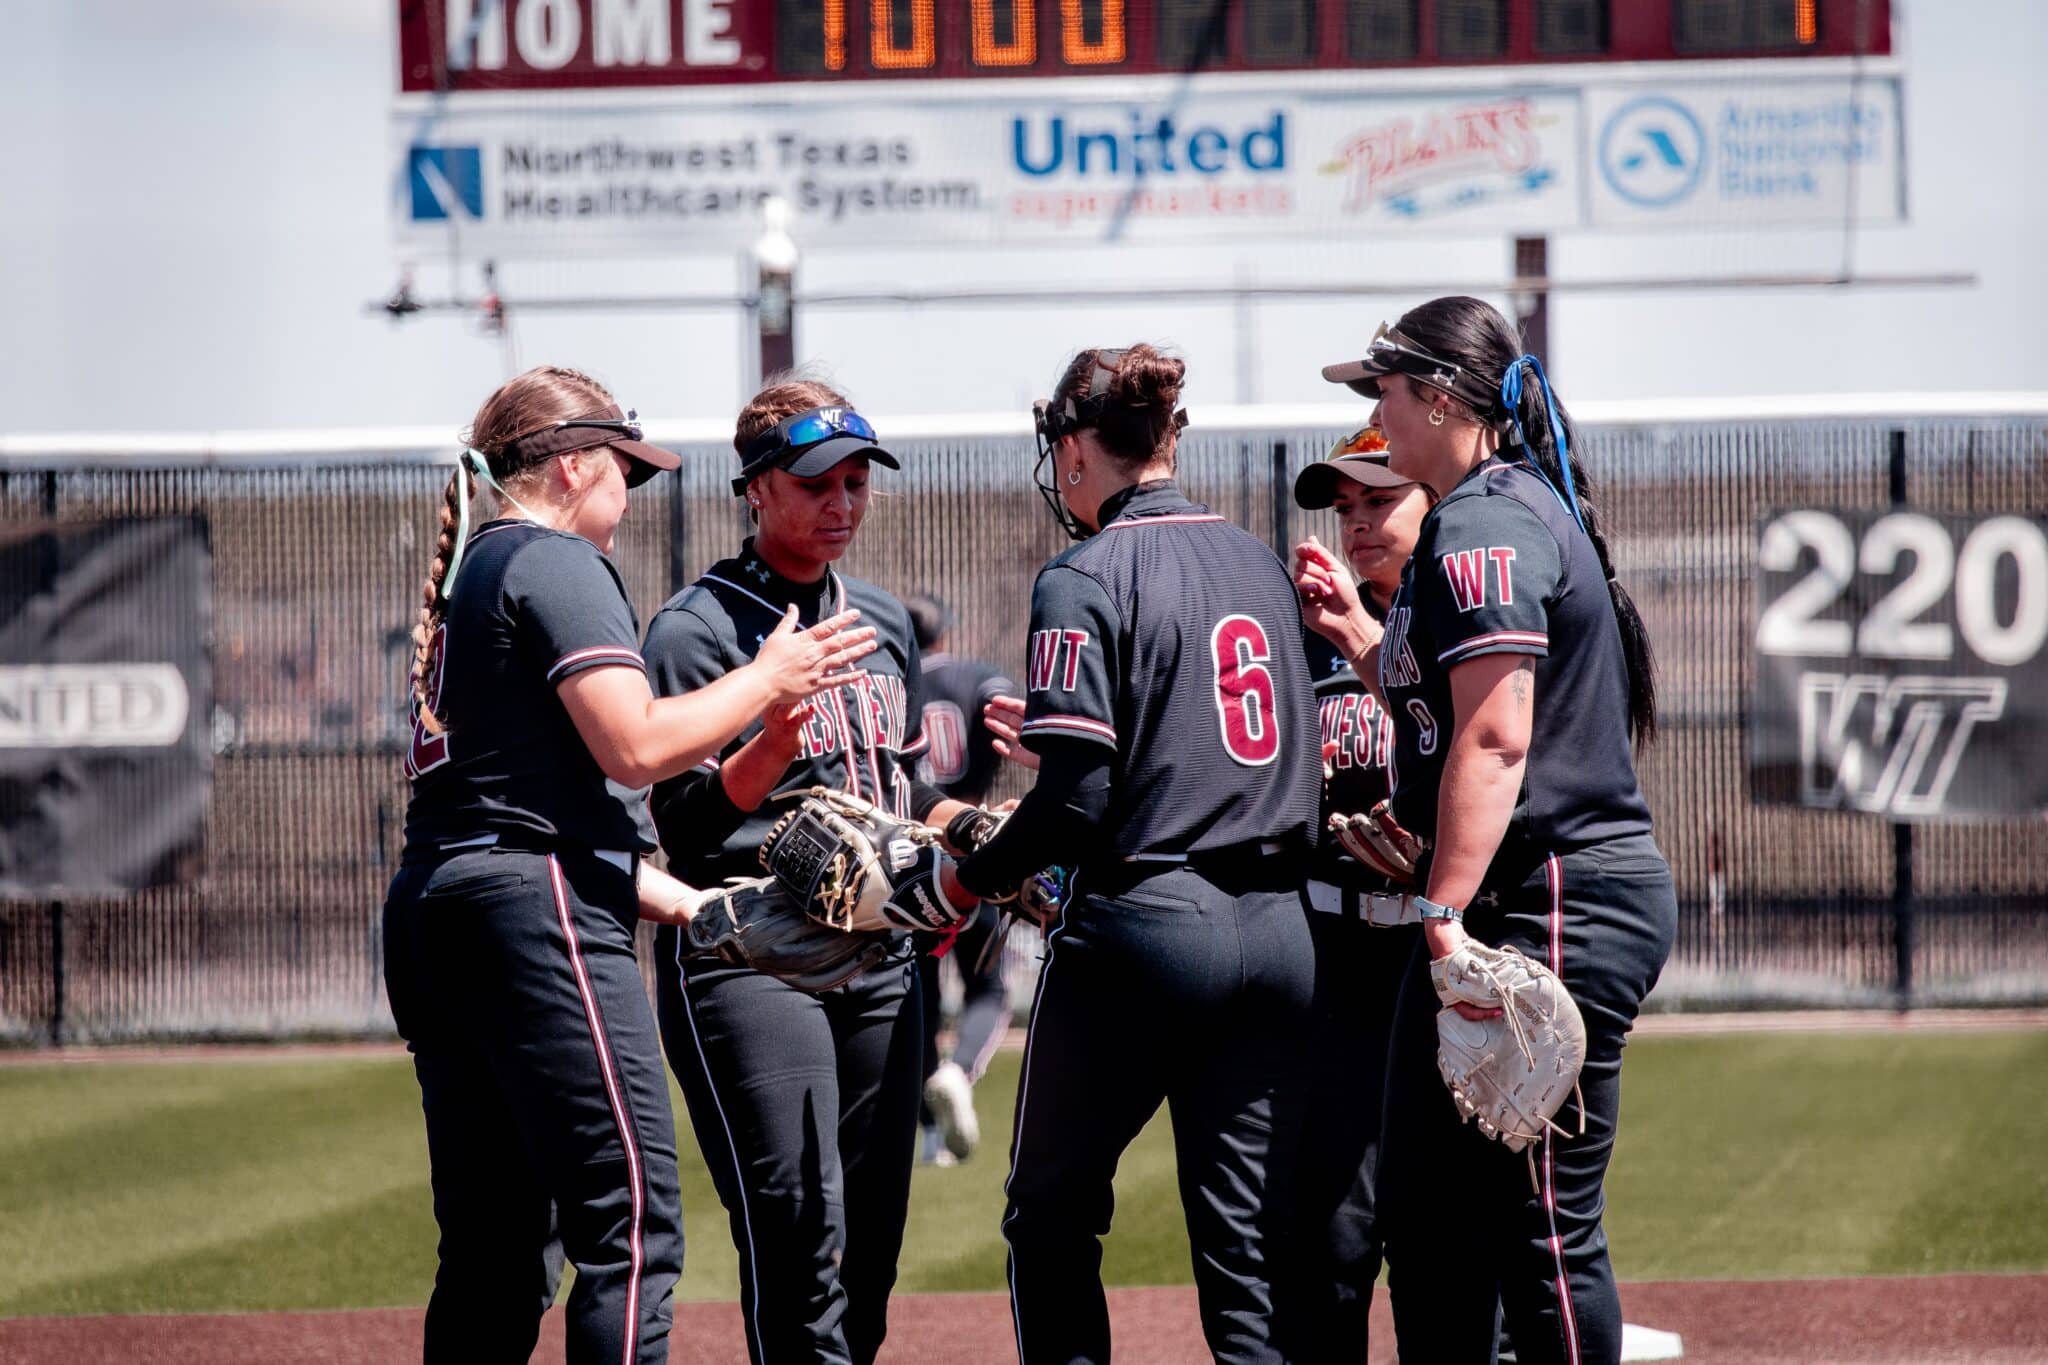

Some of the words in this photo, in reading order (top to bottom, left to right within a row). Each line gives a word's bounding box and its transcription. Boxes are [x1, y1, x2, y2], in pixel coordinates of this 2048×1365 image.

[446, 0, 741, 70] HOME
[503, 137, 758, 174] Northwest
[777, 131, 911, 170] Texas
[1012, 112, 1288, 176] United
[800, 178, 980, 222] System
[820, 409, 842, 424] WT
[1443, 547, 1516, 614] WT
[1755, 509, 2048, 666] 220
[1030, 629, 1089, 692] WT
[1210, 614, 1280, 767] 6
[1407, 698, 1438, 756] 9
[1800, 671, 2009, 815] WT
